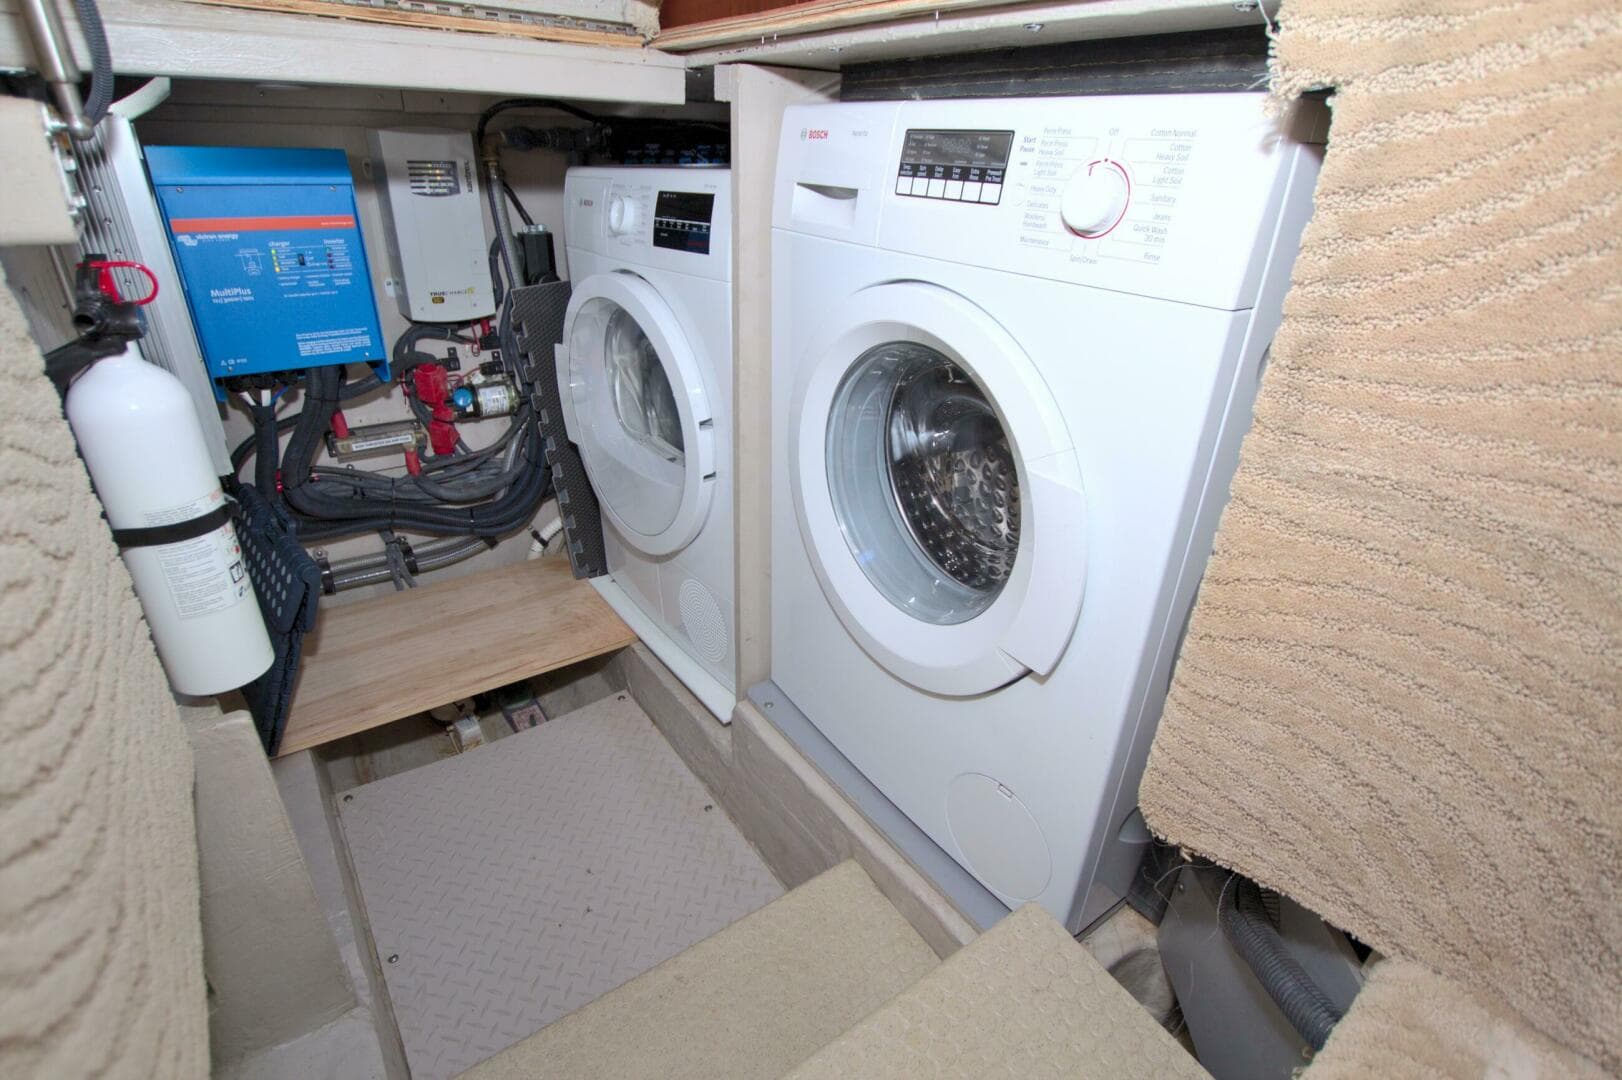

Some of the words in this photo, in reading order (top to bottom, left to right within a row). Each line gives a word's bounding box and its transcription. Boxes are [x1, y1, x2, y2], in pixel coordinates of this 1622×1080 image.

[808, 130, 829, 139] BOSCH
[1023, 136, 1037, 144] Start
[1019, 145, 1036, 153] Pause
[210, 287, 252, 298] MultiPlus
